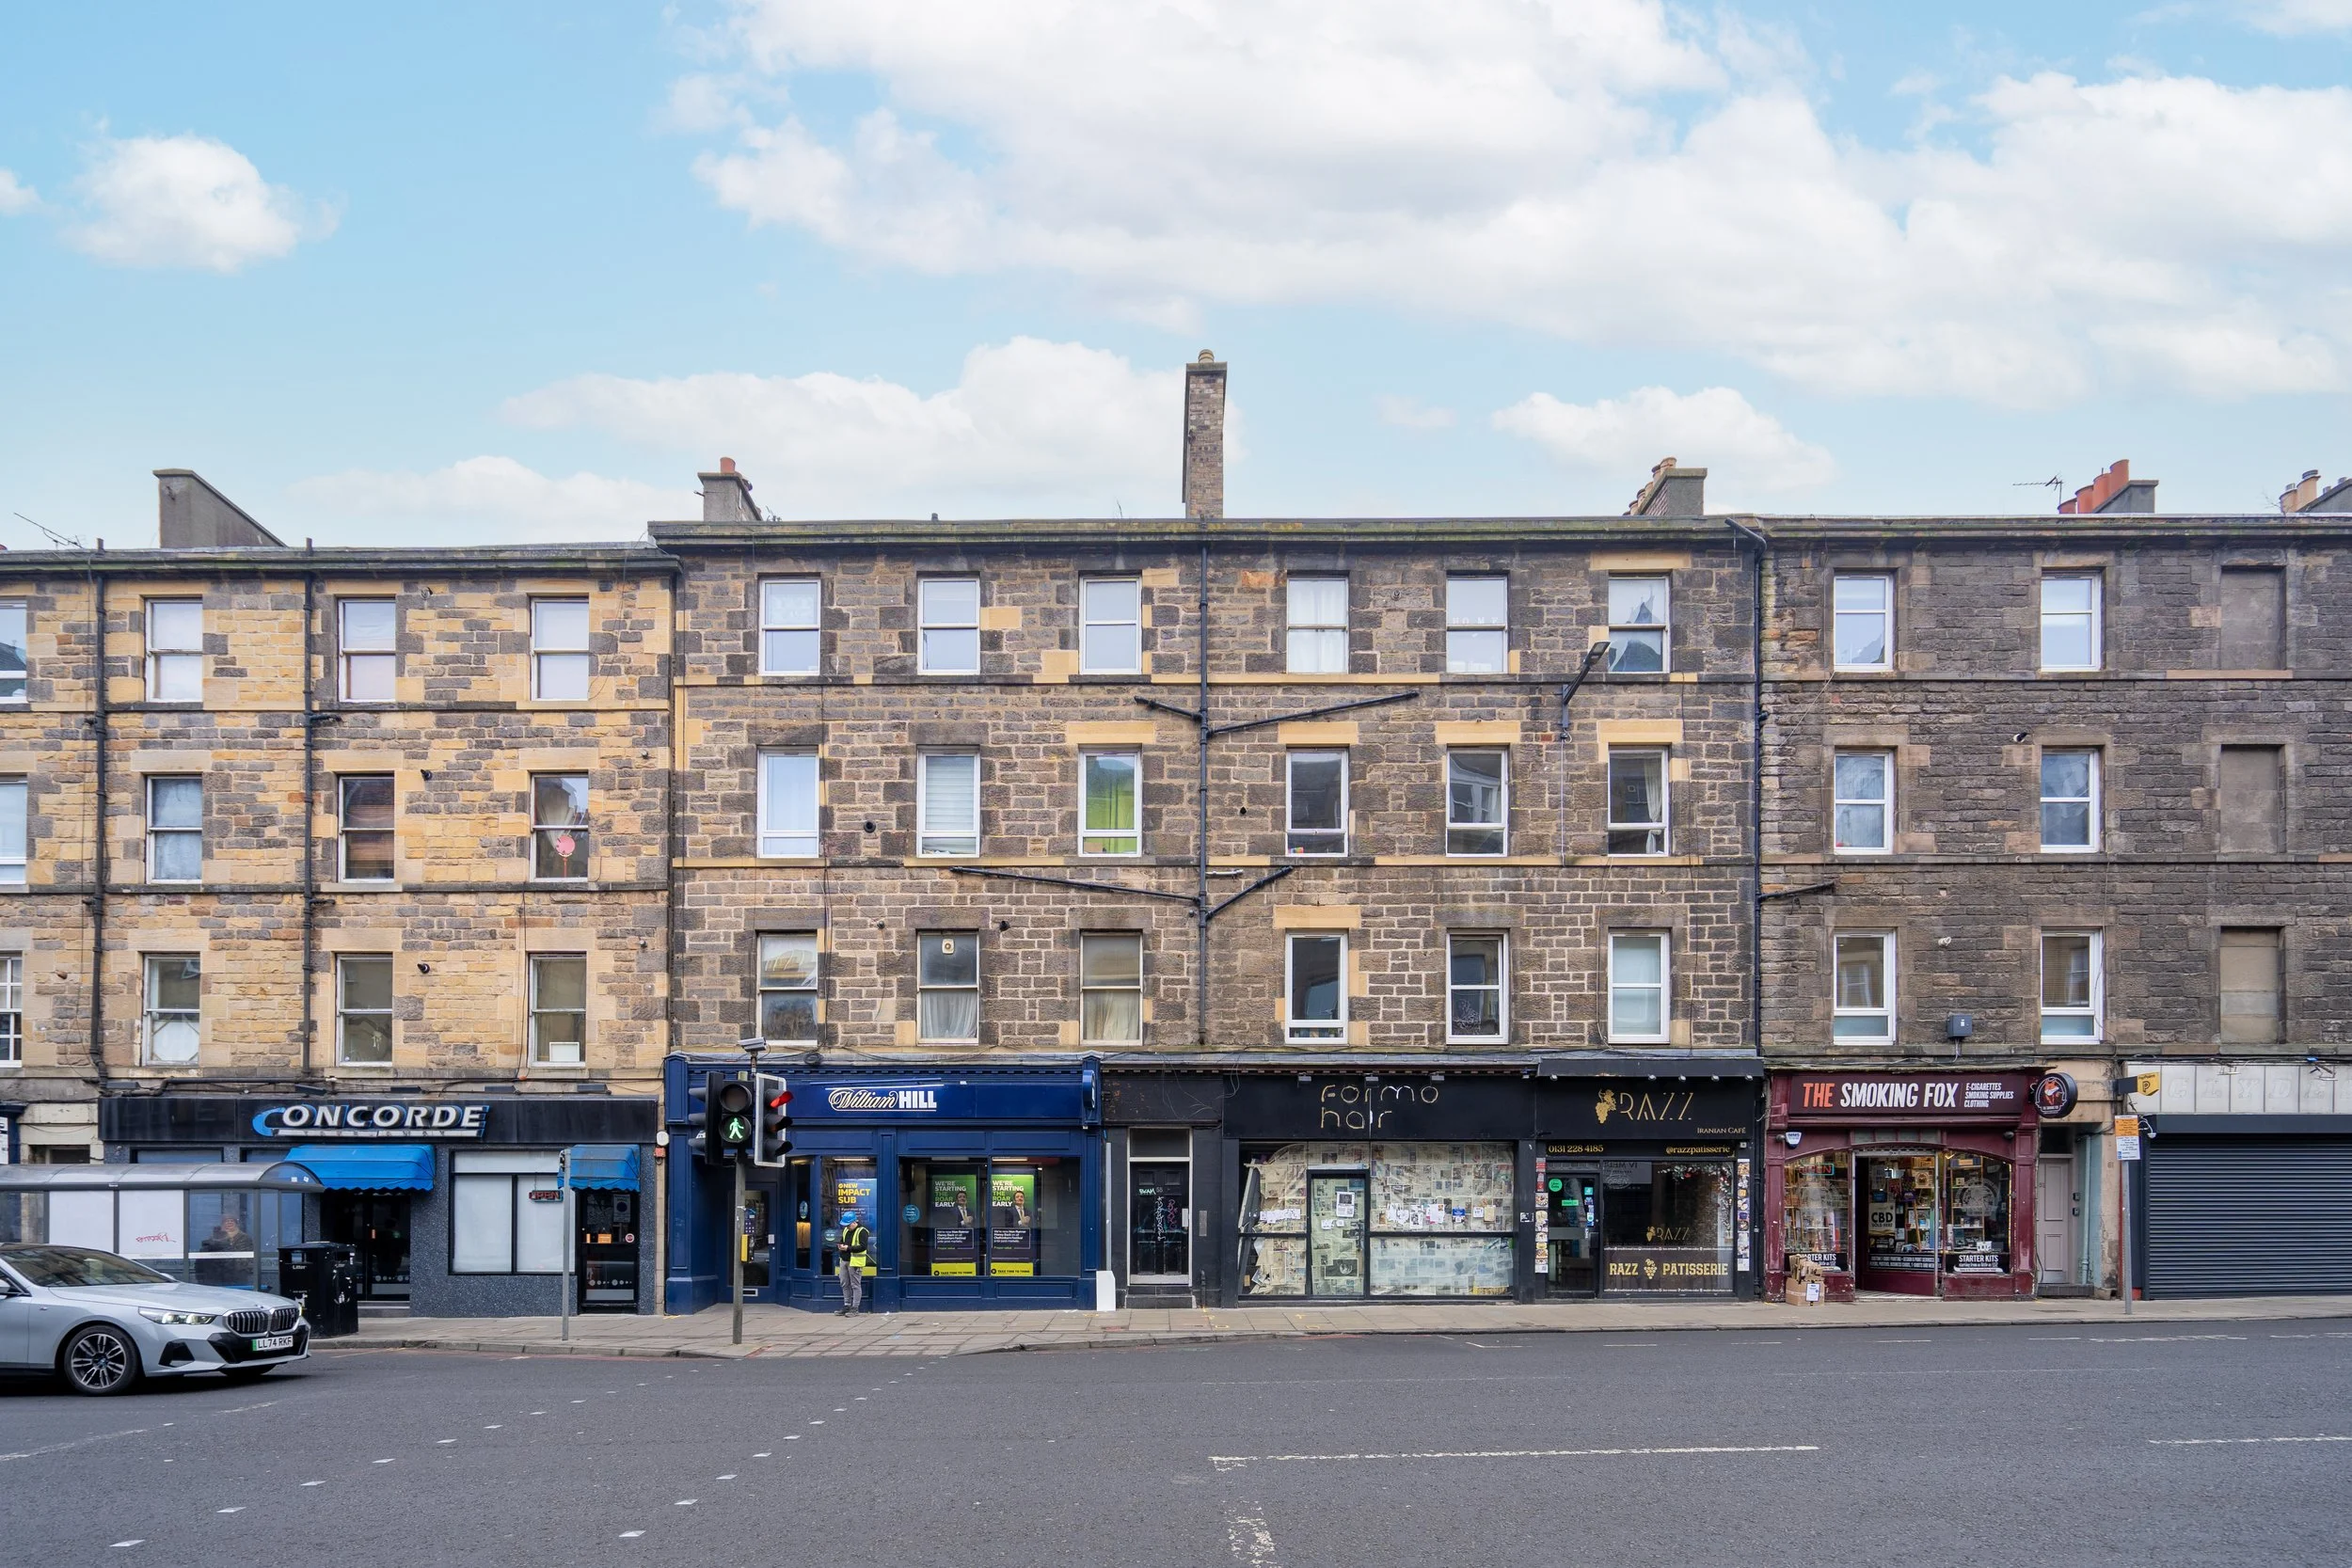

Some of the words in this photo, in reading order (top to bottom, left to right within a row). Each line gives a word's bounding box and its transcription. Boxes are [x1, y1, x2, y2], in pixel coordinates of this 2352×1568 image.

[1966, 1083, 2002, 1091] E-CIGARETTES
[828, 1088, 898, 1109] William
[898, 1090, 937, 1109] HILL
[1803, 1083, 1835, 1107] THE
[1840, 1083, 1918, 1108] SMOKING
[1923, 1083, 1959, 1108] FOX
[1964, 1091, 1989, 1100] SMOKING
[1989, 1091, 2014, 1100] SUPPLIES
[1619, 1092, 1694, 1120] RAZZ
[1963, 1100, 1990, 1108] CLOTHING
[252, 1104, 489, 1136] CONCORDE
[1549, 1145, 1566, 1153] 0131
[1567, 1145, 1583, 1153] 228
[1666, 1146, 1730, 1155] @razzpatisserie
[1871, 1212, 1893, 1224] CBD
[1657, 1227, 1691, 1241] RAZZ
[1823, 1253, 1836, 1261] KITS
[1959, 1254, 1984, 1262] STARTER
[1985, 1254, 1999, 1262] KITS
[1610, 1263, 1639, 1275] RAZZ
[1662, 1263, 1729, 1275] PATISSERIE
[258, 1338, 277, 1349] LL74
